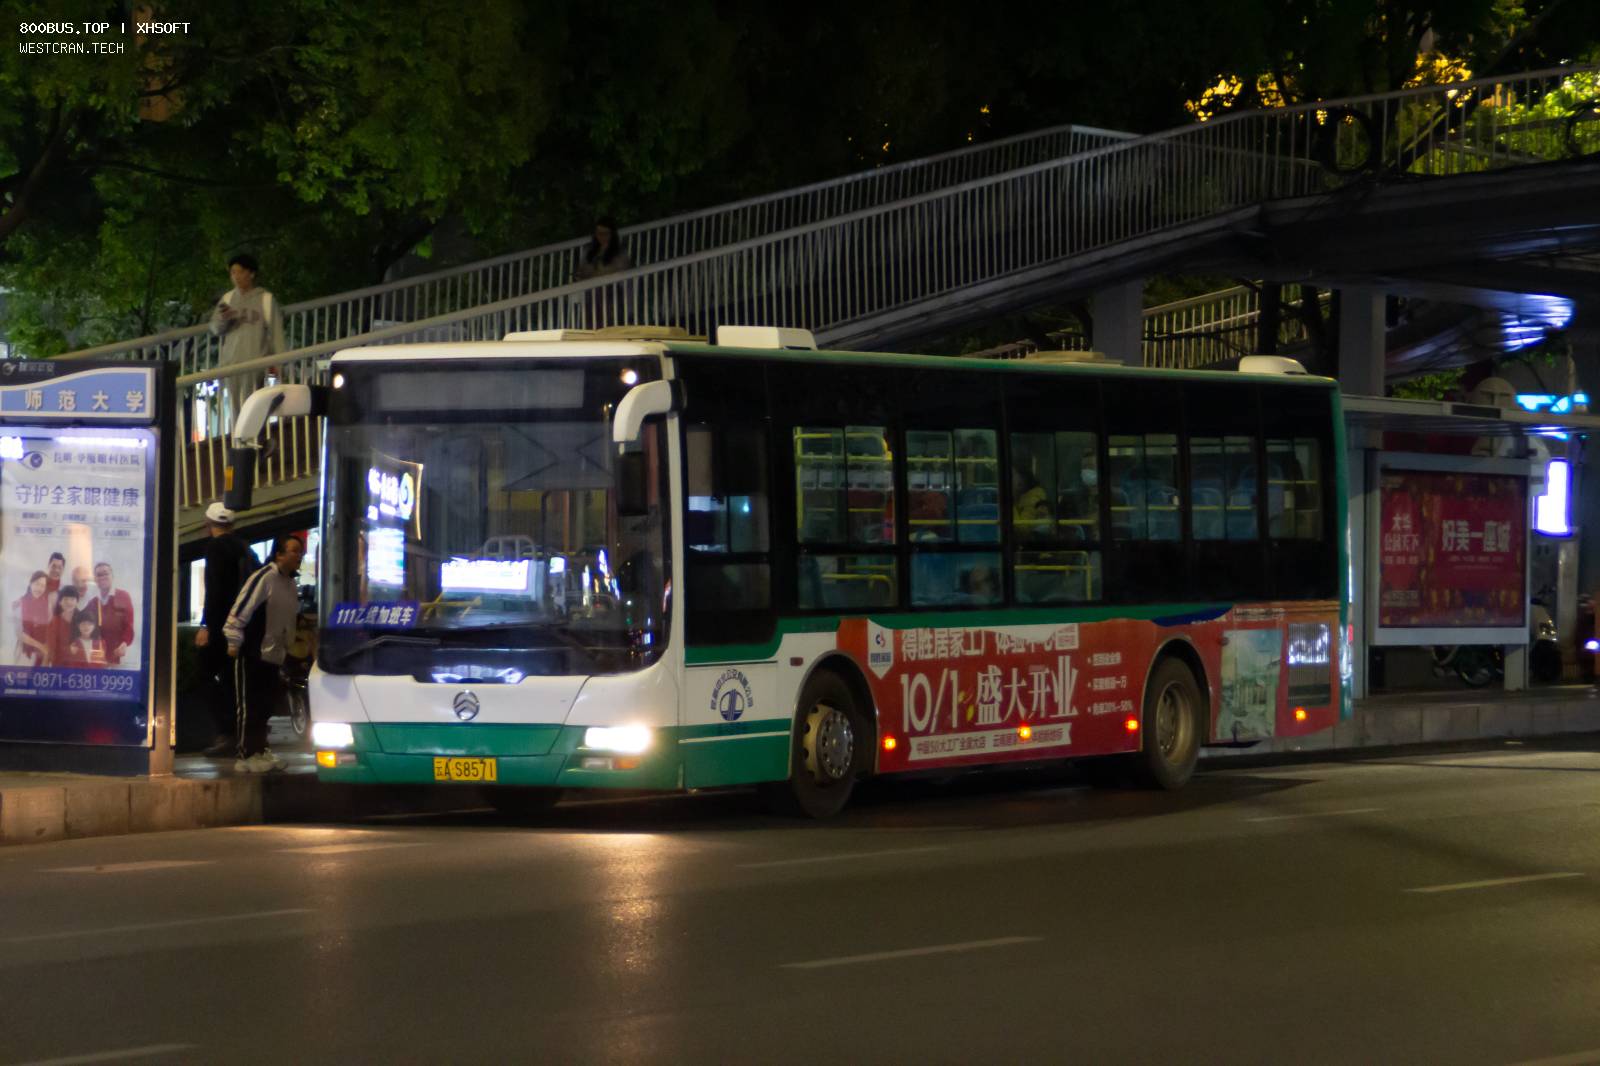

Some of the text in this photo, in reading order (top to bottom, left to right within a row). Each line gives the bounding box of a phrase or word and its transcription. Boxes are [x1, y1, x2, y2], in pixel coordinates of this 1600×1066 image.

[25, 389, 144, 412] 师范大学
[16, 484, 139, 507] 守护全家眼健康
[337, 606, 414, 625] 111乙线加班车
[33, 672, 98, 688] 0871-6381
[102, 676, 133, 691] 9999
[901, 655, 1079, 733] 10/1 盛大开业
